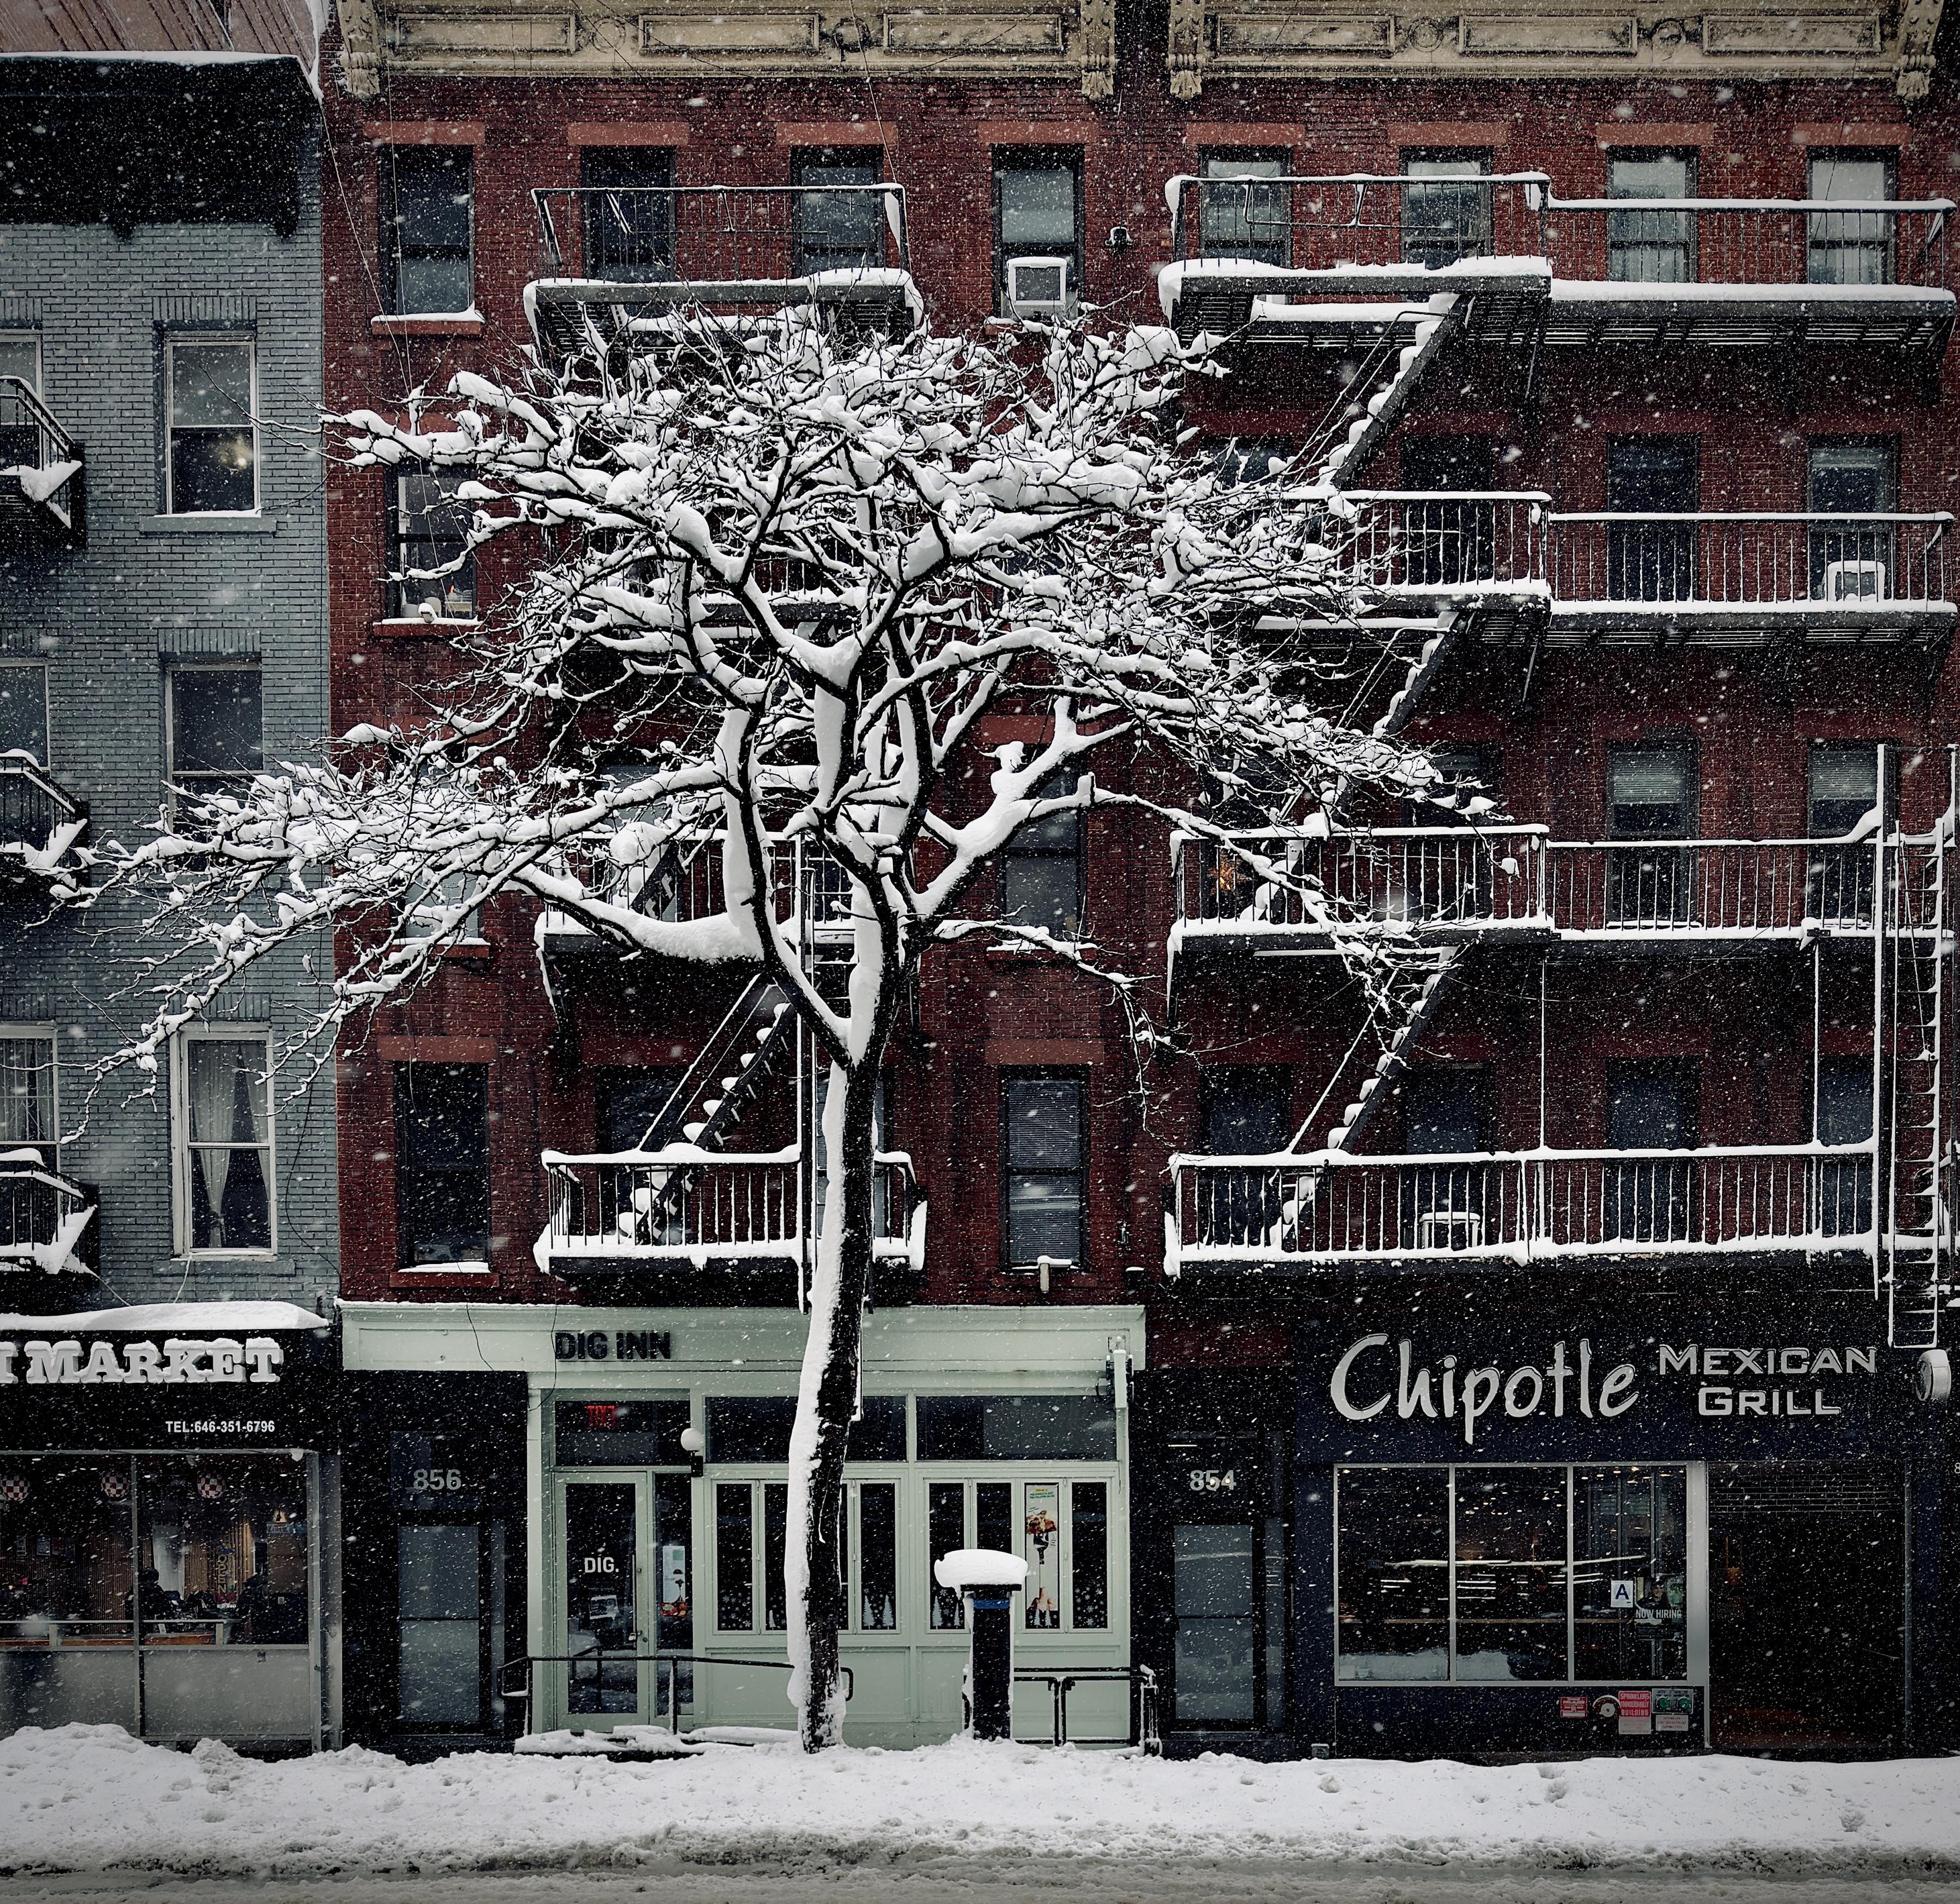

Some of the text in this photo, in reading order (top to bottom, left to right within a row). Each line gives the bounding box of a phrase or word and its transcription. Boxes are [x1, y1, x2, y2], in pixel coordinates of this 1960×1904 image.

[555, 1332, 671, 1359] DIG INN
[24, 1338, 284, 1383] MARKET
[1659, 1344, 1877, 1375] MEXICAN
[1330, 1333, 1639, 1445] Chipotle
[1698, 1387, 1842, 1416] GRILL
[165, 1420, 275, 1433] TEL:646-351-6796
[413, 1469, 461, 1490] 856
[1190, 1469, 1236, 1491] 854
[218, 1554, 227, 1593] OPEN
[584, 1557, 619, 1573] DIG.
[1615, 1584, 1629, 1600] A
[1635, 1609, 1682, 1619] NOW HIRING
